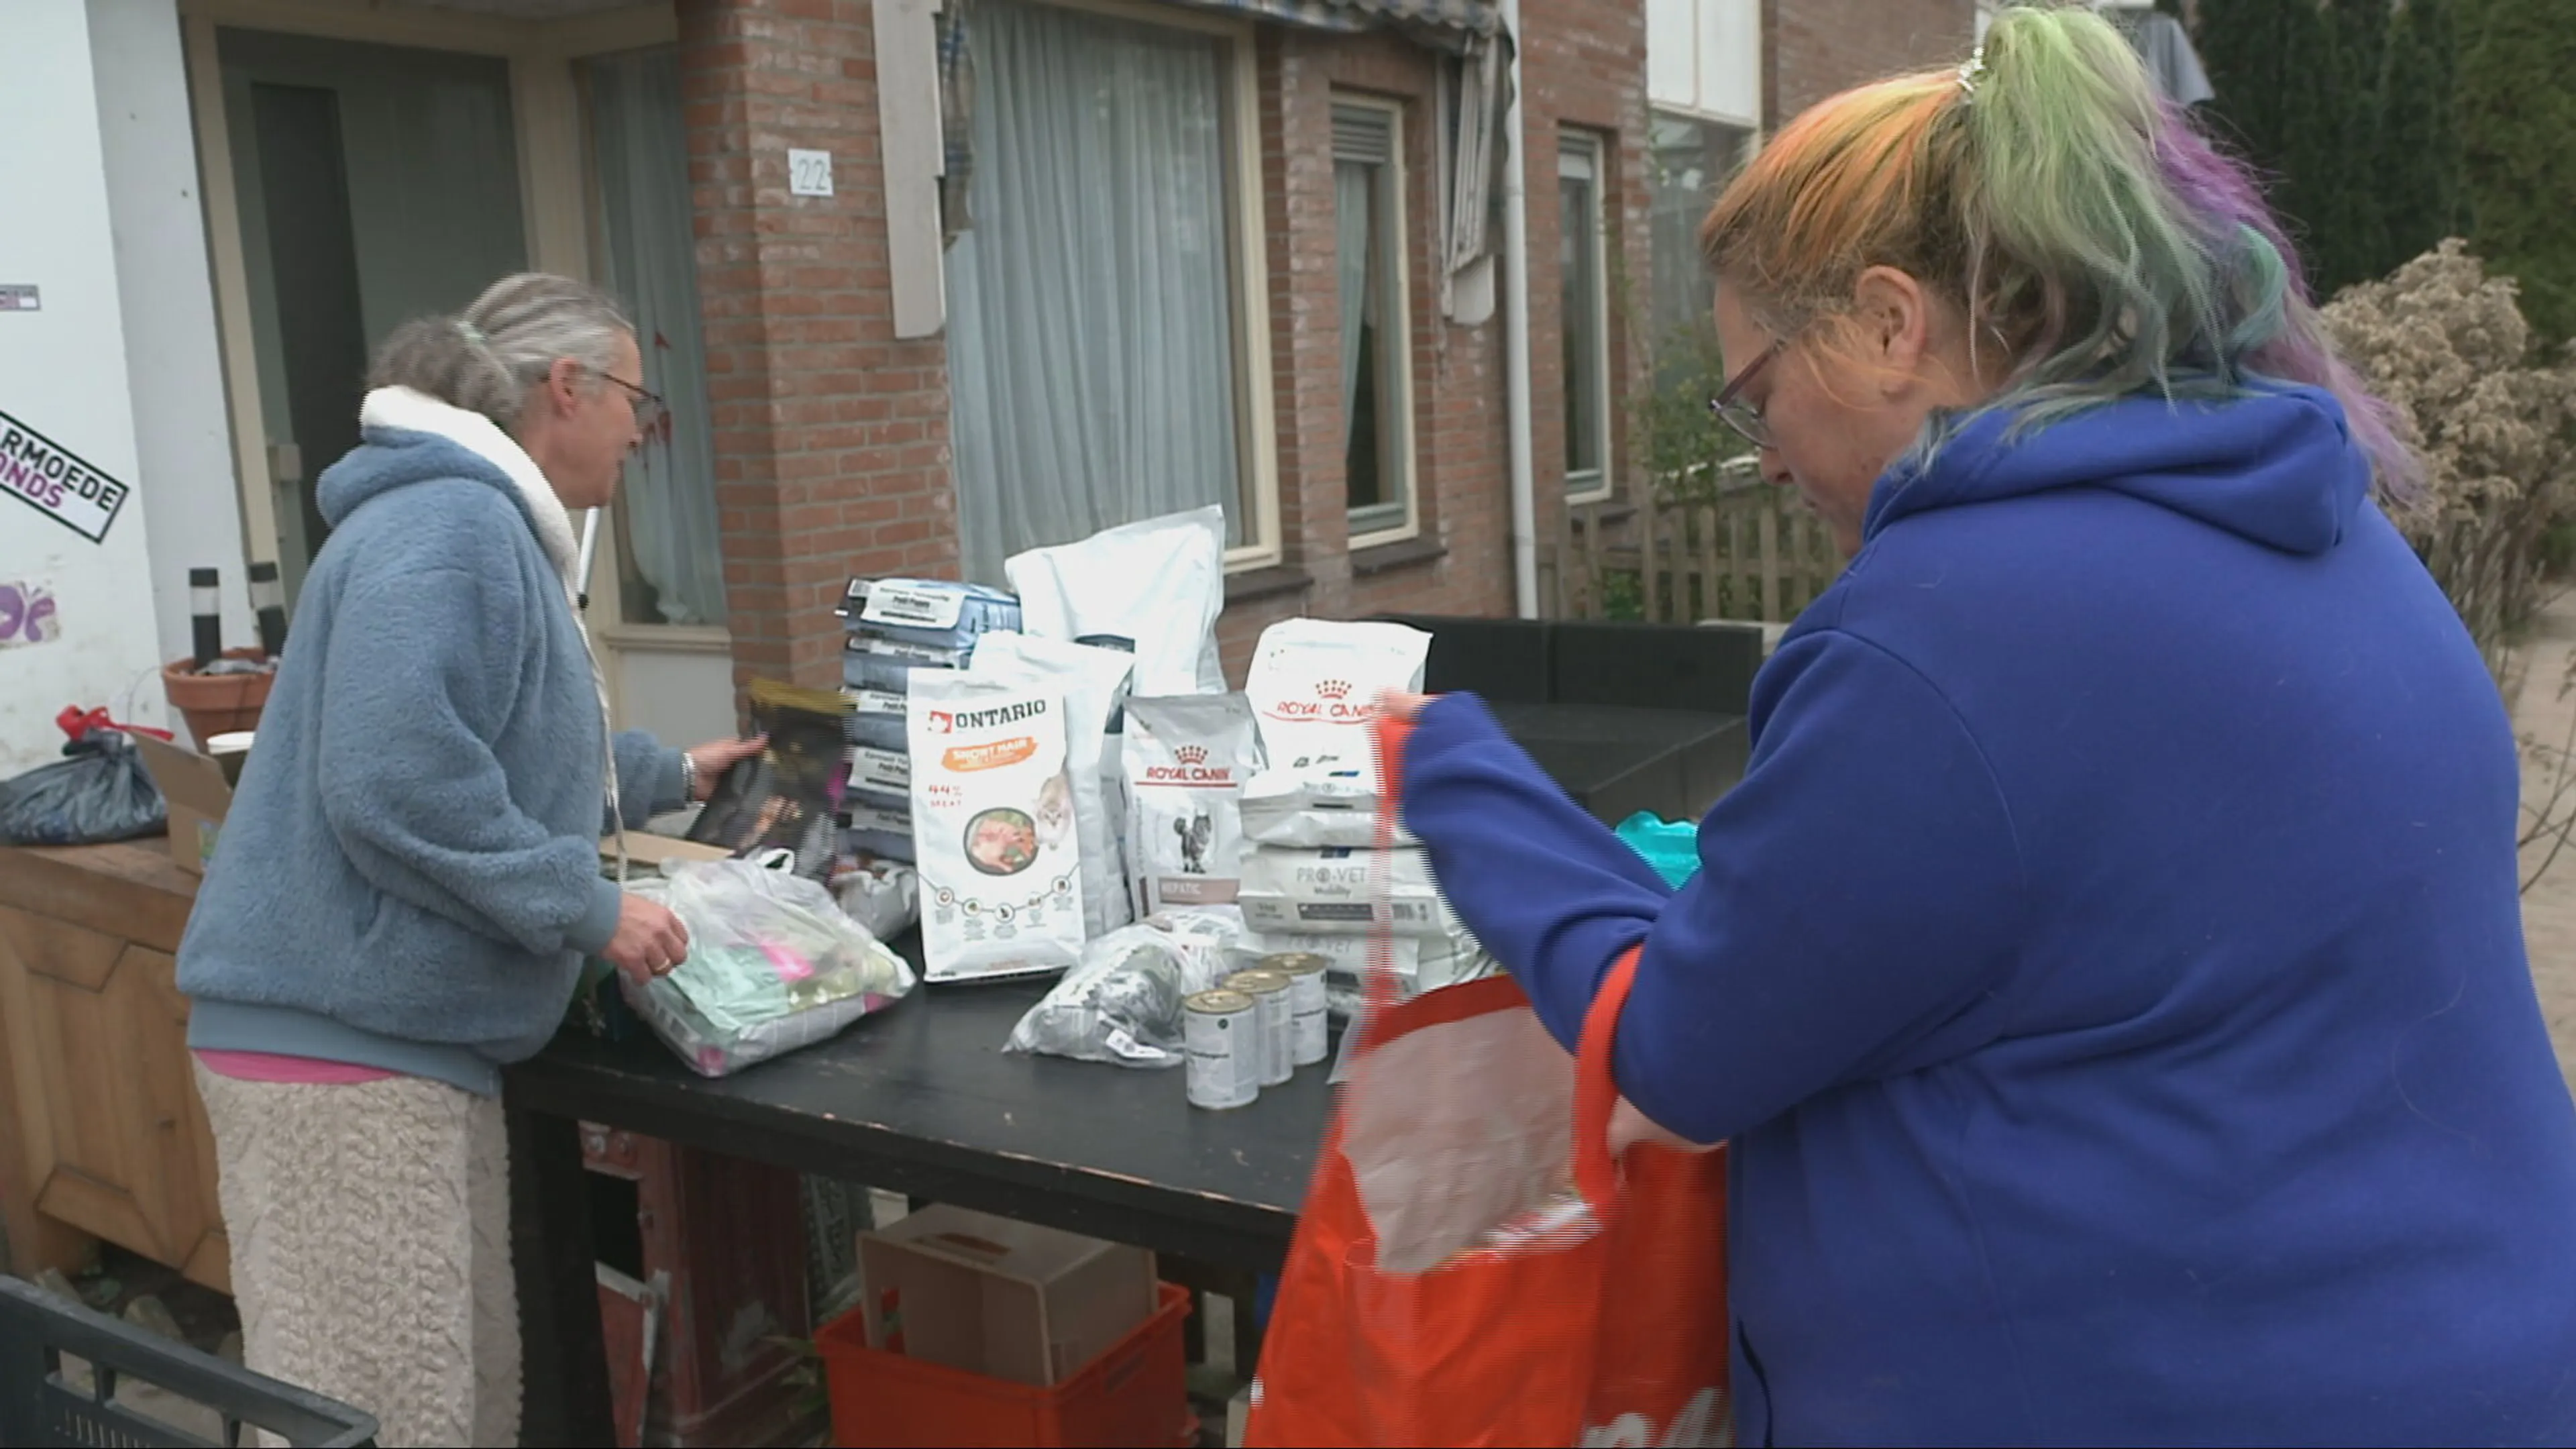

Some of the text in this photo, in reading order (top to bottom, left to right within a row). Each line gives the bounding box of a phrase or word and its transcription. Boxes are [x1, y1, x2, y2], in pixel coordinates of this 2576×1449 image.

[798, 158, 828, 191] 22
[0, 427, 119, 512] RMOEDE
[955, 699, 1046, 729] ONTARIO
[1146, 766, 1230, 781] ROYAL CANIN
